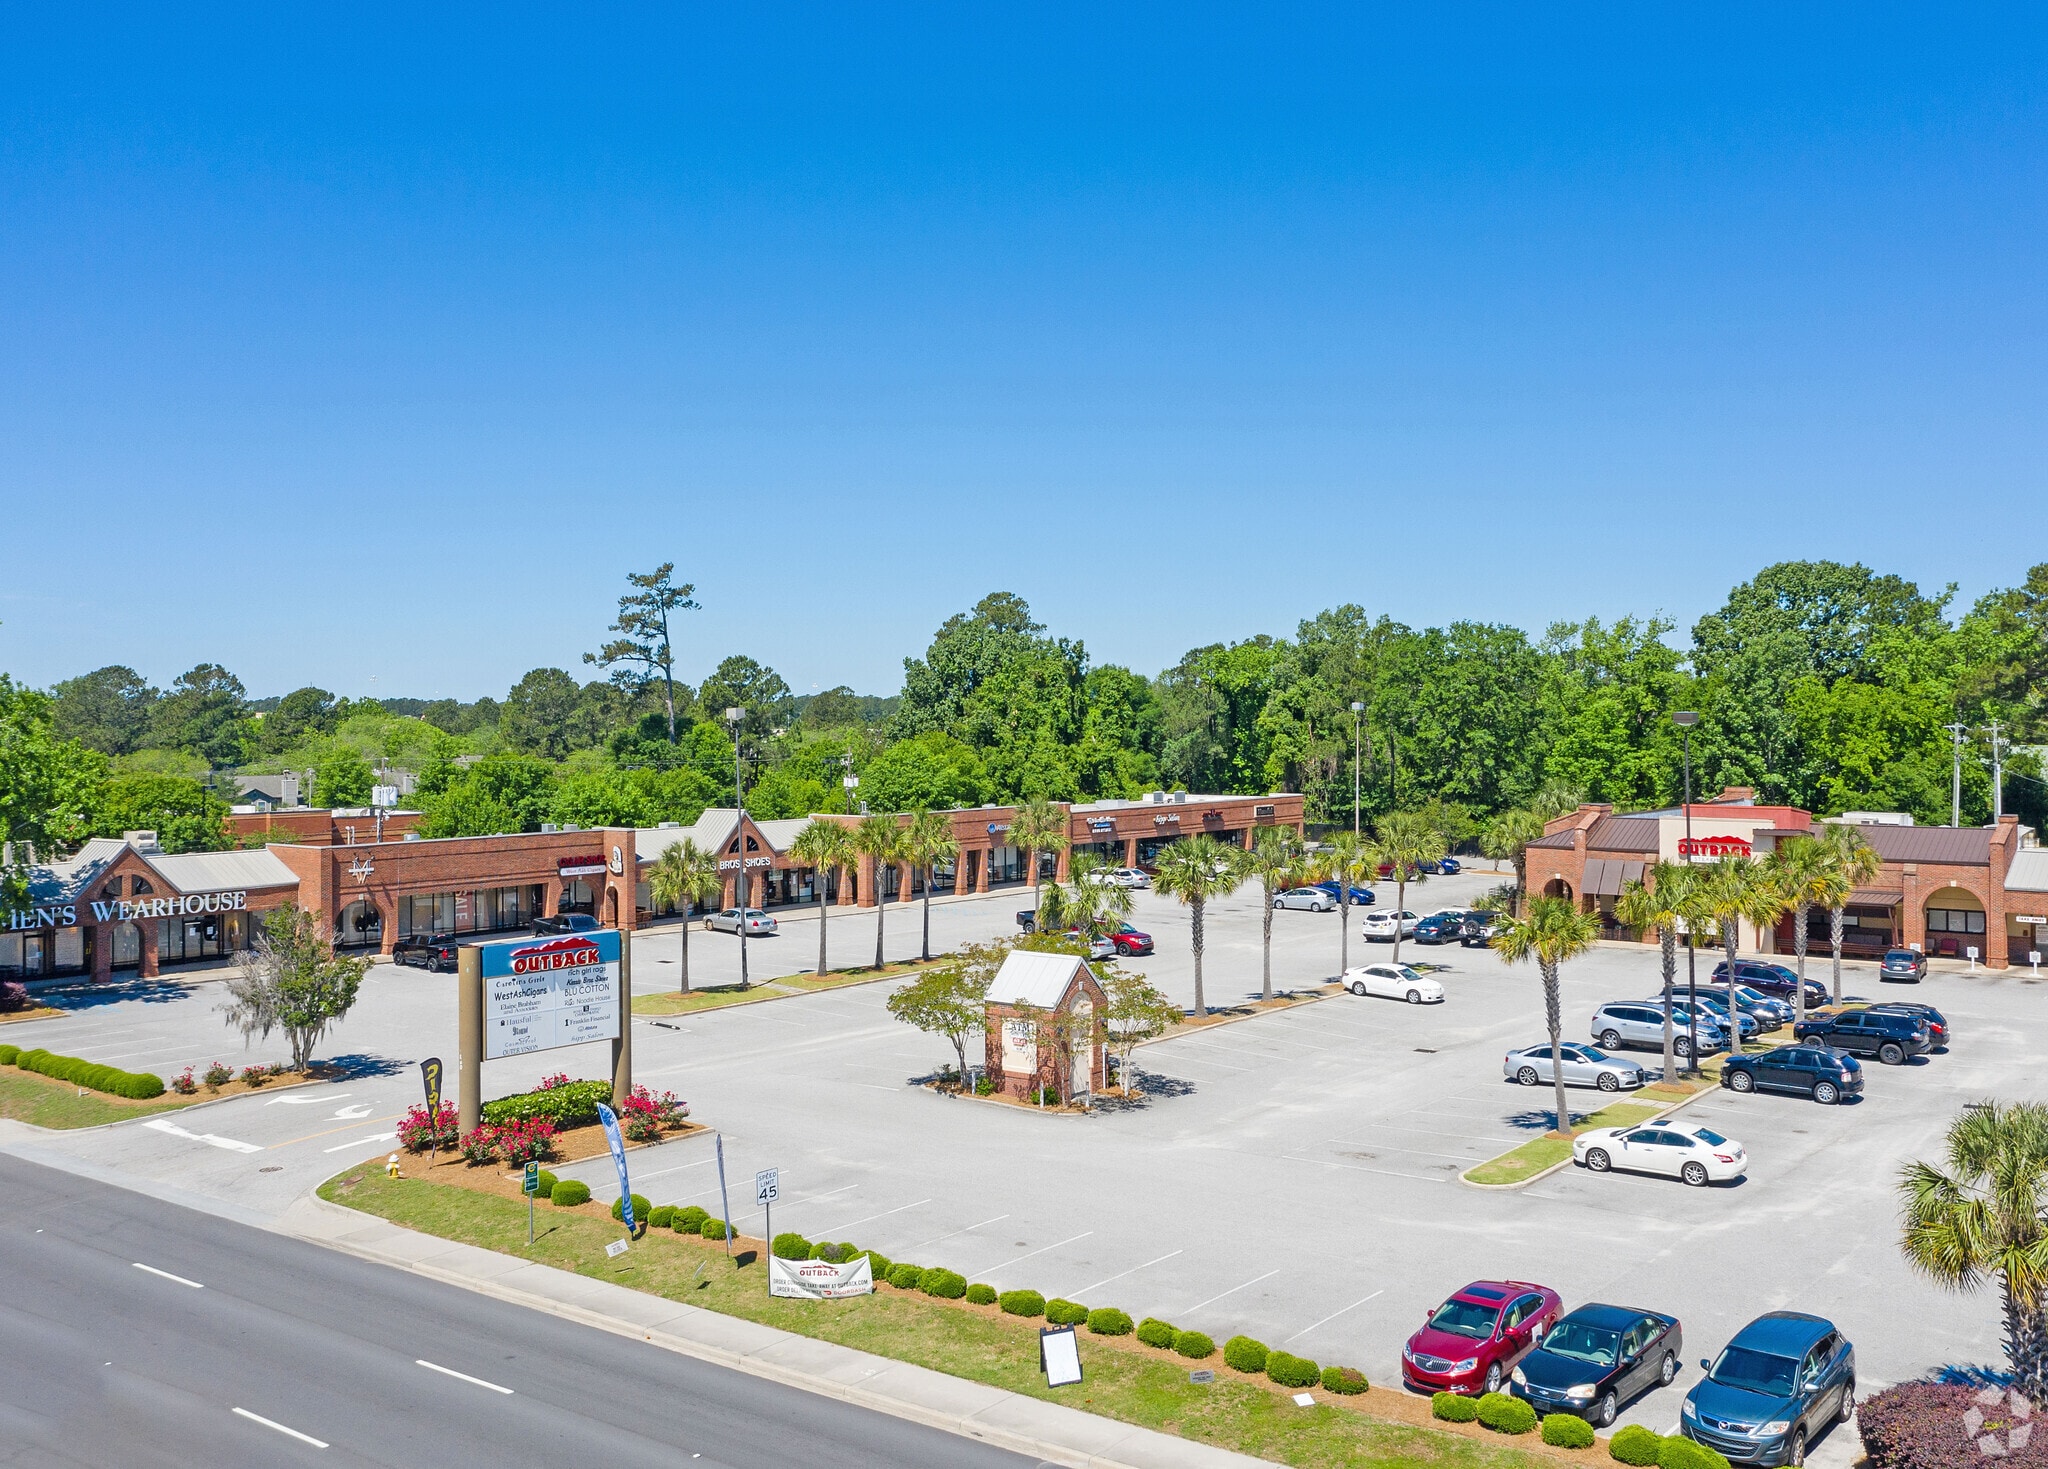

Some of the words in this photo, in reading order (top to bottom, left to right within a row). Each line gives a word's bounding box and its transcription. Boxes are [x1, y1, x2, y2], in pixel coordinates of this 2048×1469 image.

[1678, 844, 1752, 857] OUTBACK
[720, 859, 741, 870] BROS
[745, 857, 771, 868] SHOES
[91, 891, 247, 922] WEARHOUSE
[513, 949, 599, 974] OUTBACK
[494, 987, 548, 1001] WestAshCigars
[564, 988, 578, 997] BLU
[579, 983, 610, 995] COTTON
[506, 1015, 532, 1026] Hausful
[758, 1171, 776, 1181] SPEED
[760, 1179, 774, 1187] LIMIT
[759, 1185, 777, 1199] 45
[799, 1269, 840, 1277] OUTBACK
[773, 1278, 786, 1286] ORDER
[833, 1287, 867, 1296] DOORDASH
